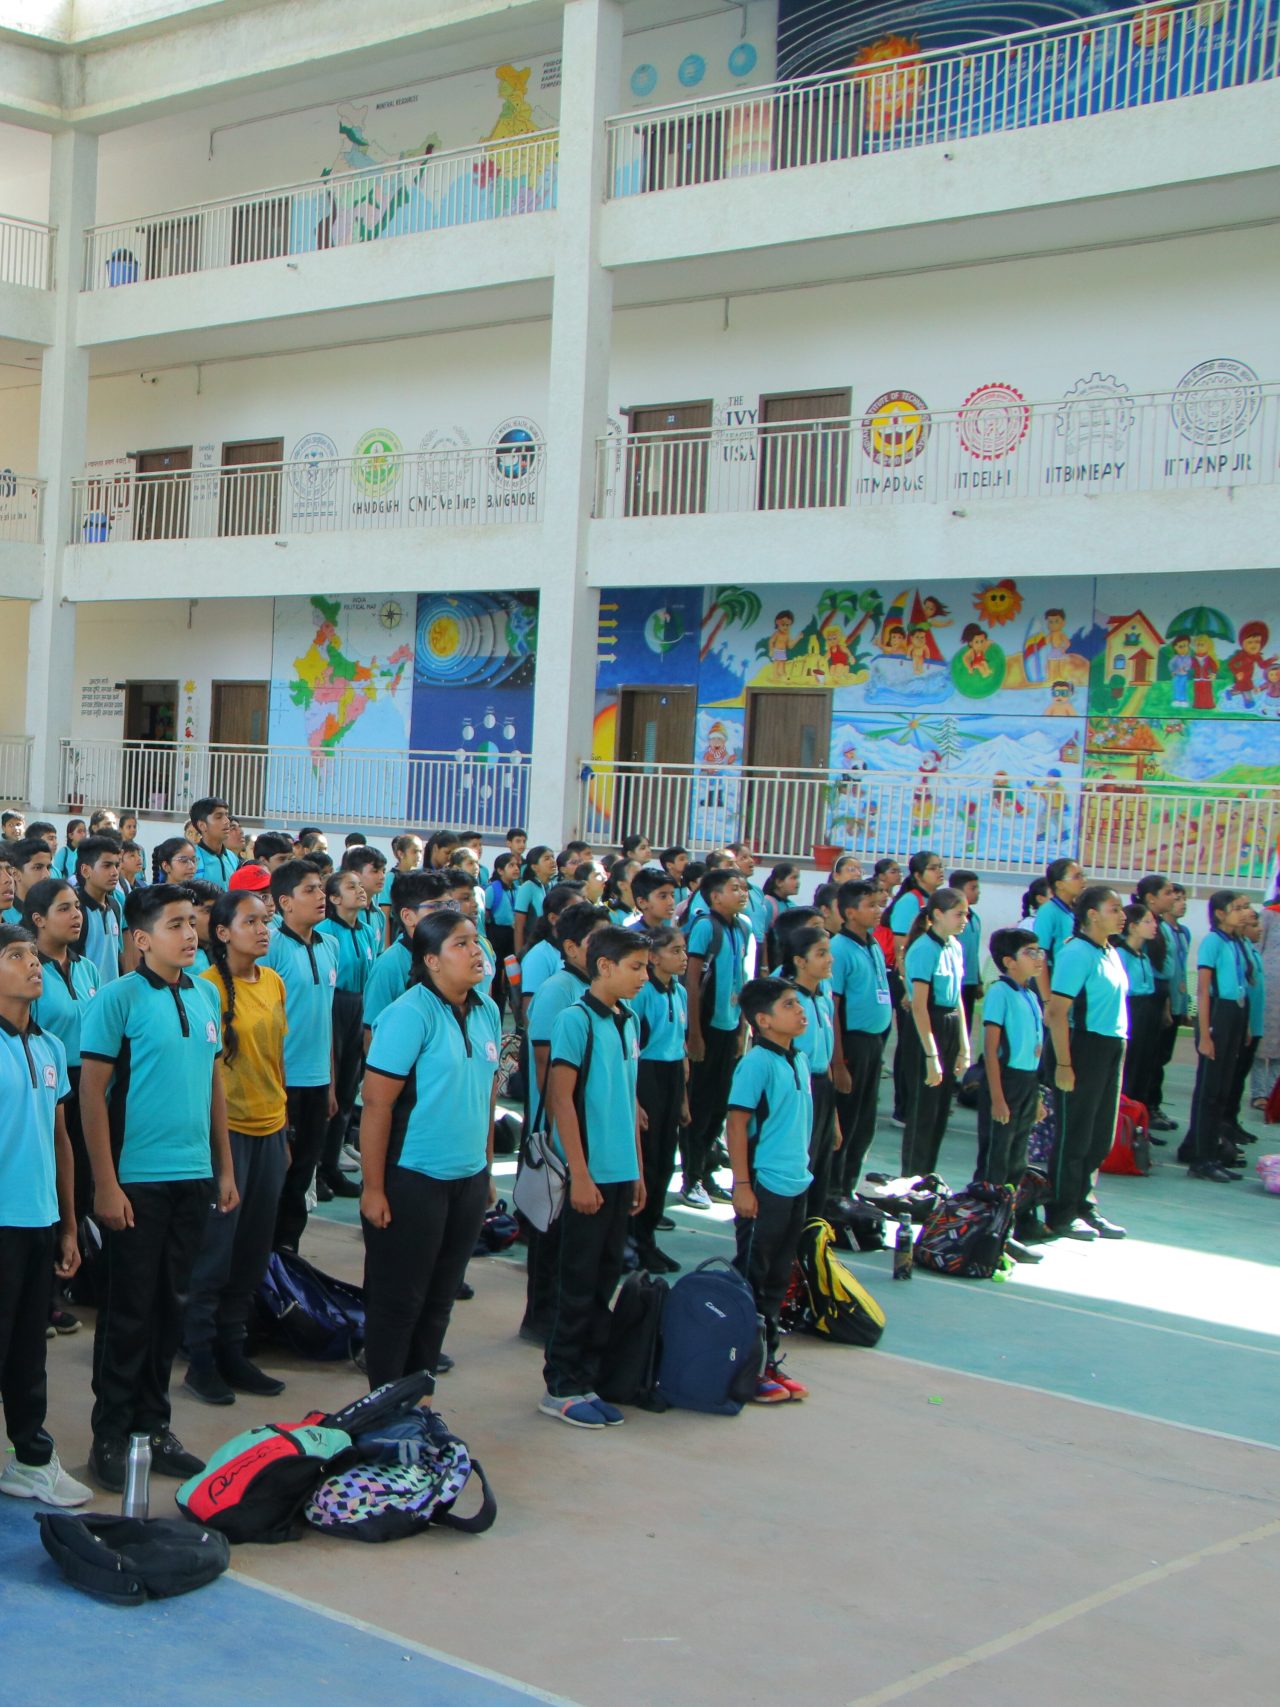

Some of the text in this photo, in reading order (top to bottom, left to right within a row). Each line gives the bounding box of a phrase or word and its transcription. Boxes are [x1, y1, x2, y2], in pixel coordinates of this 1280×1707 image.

[728, 396, 744, 406] THE
[726, 409, 758, 426] IVY
[723, 446, 756, 462] USA
[856, 477, 870, 494] IIT
[954, 471, 969, 489] IIT
